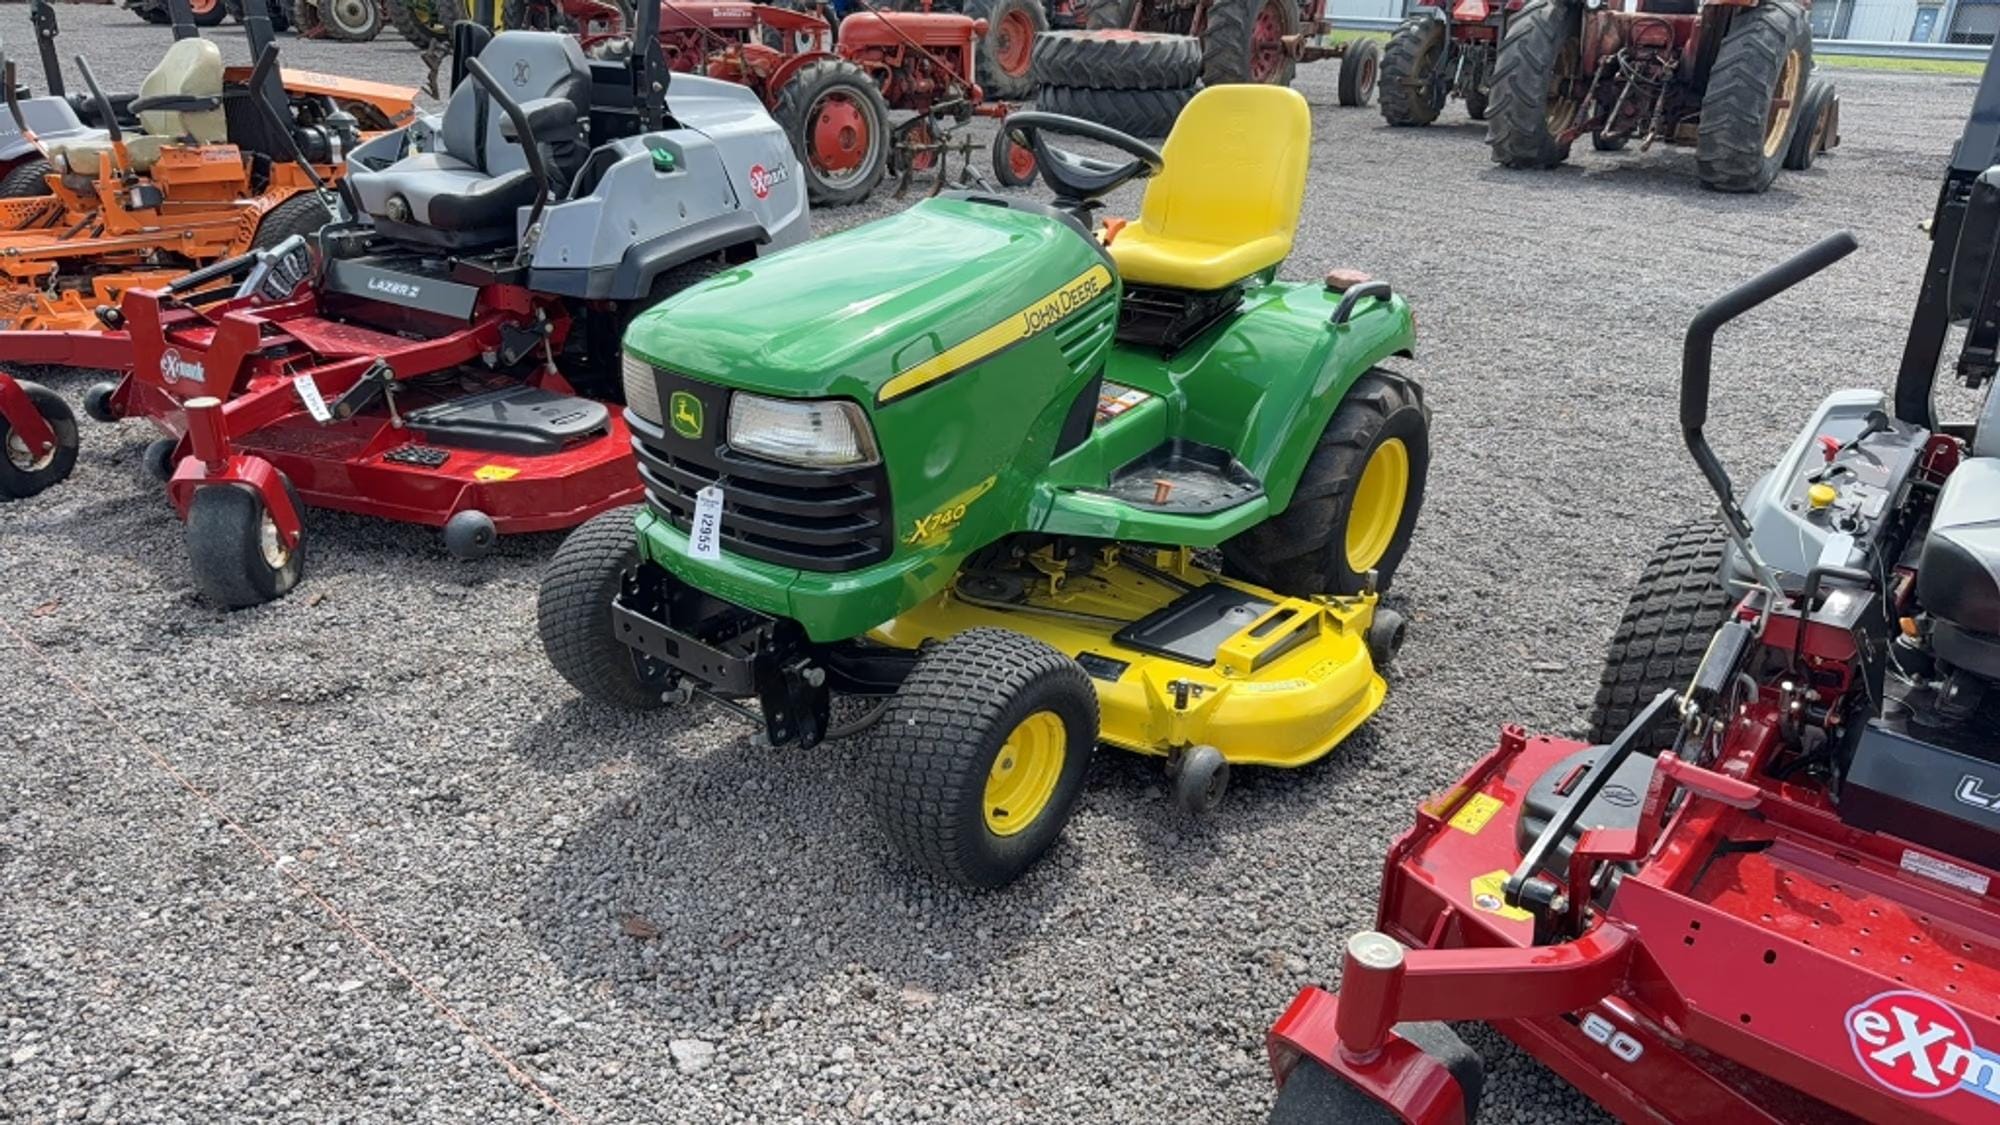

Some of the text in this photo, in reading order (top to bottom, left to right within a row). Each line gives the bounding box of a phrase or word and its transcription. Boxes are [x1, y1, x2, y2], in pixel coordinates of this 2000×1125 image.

[368, 277, 409, 295] LAZER
[1023, 276, 1099, 335] JOHN DEERE
[697, 513, 714, 552] 12955
[910, 504, 966, 543] X740
